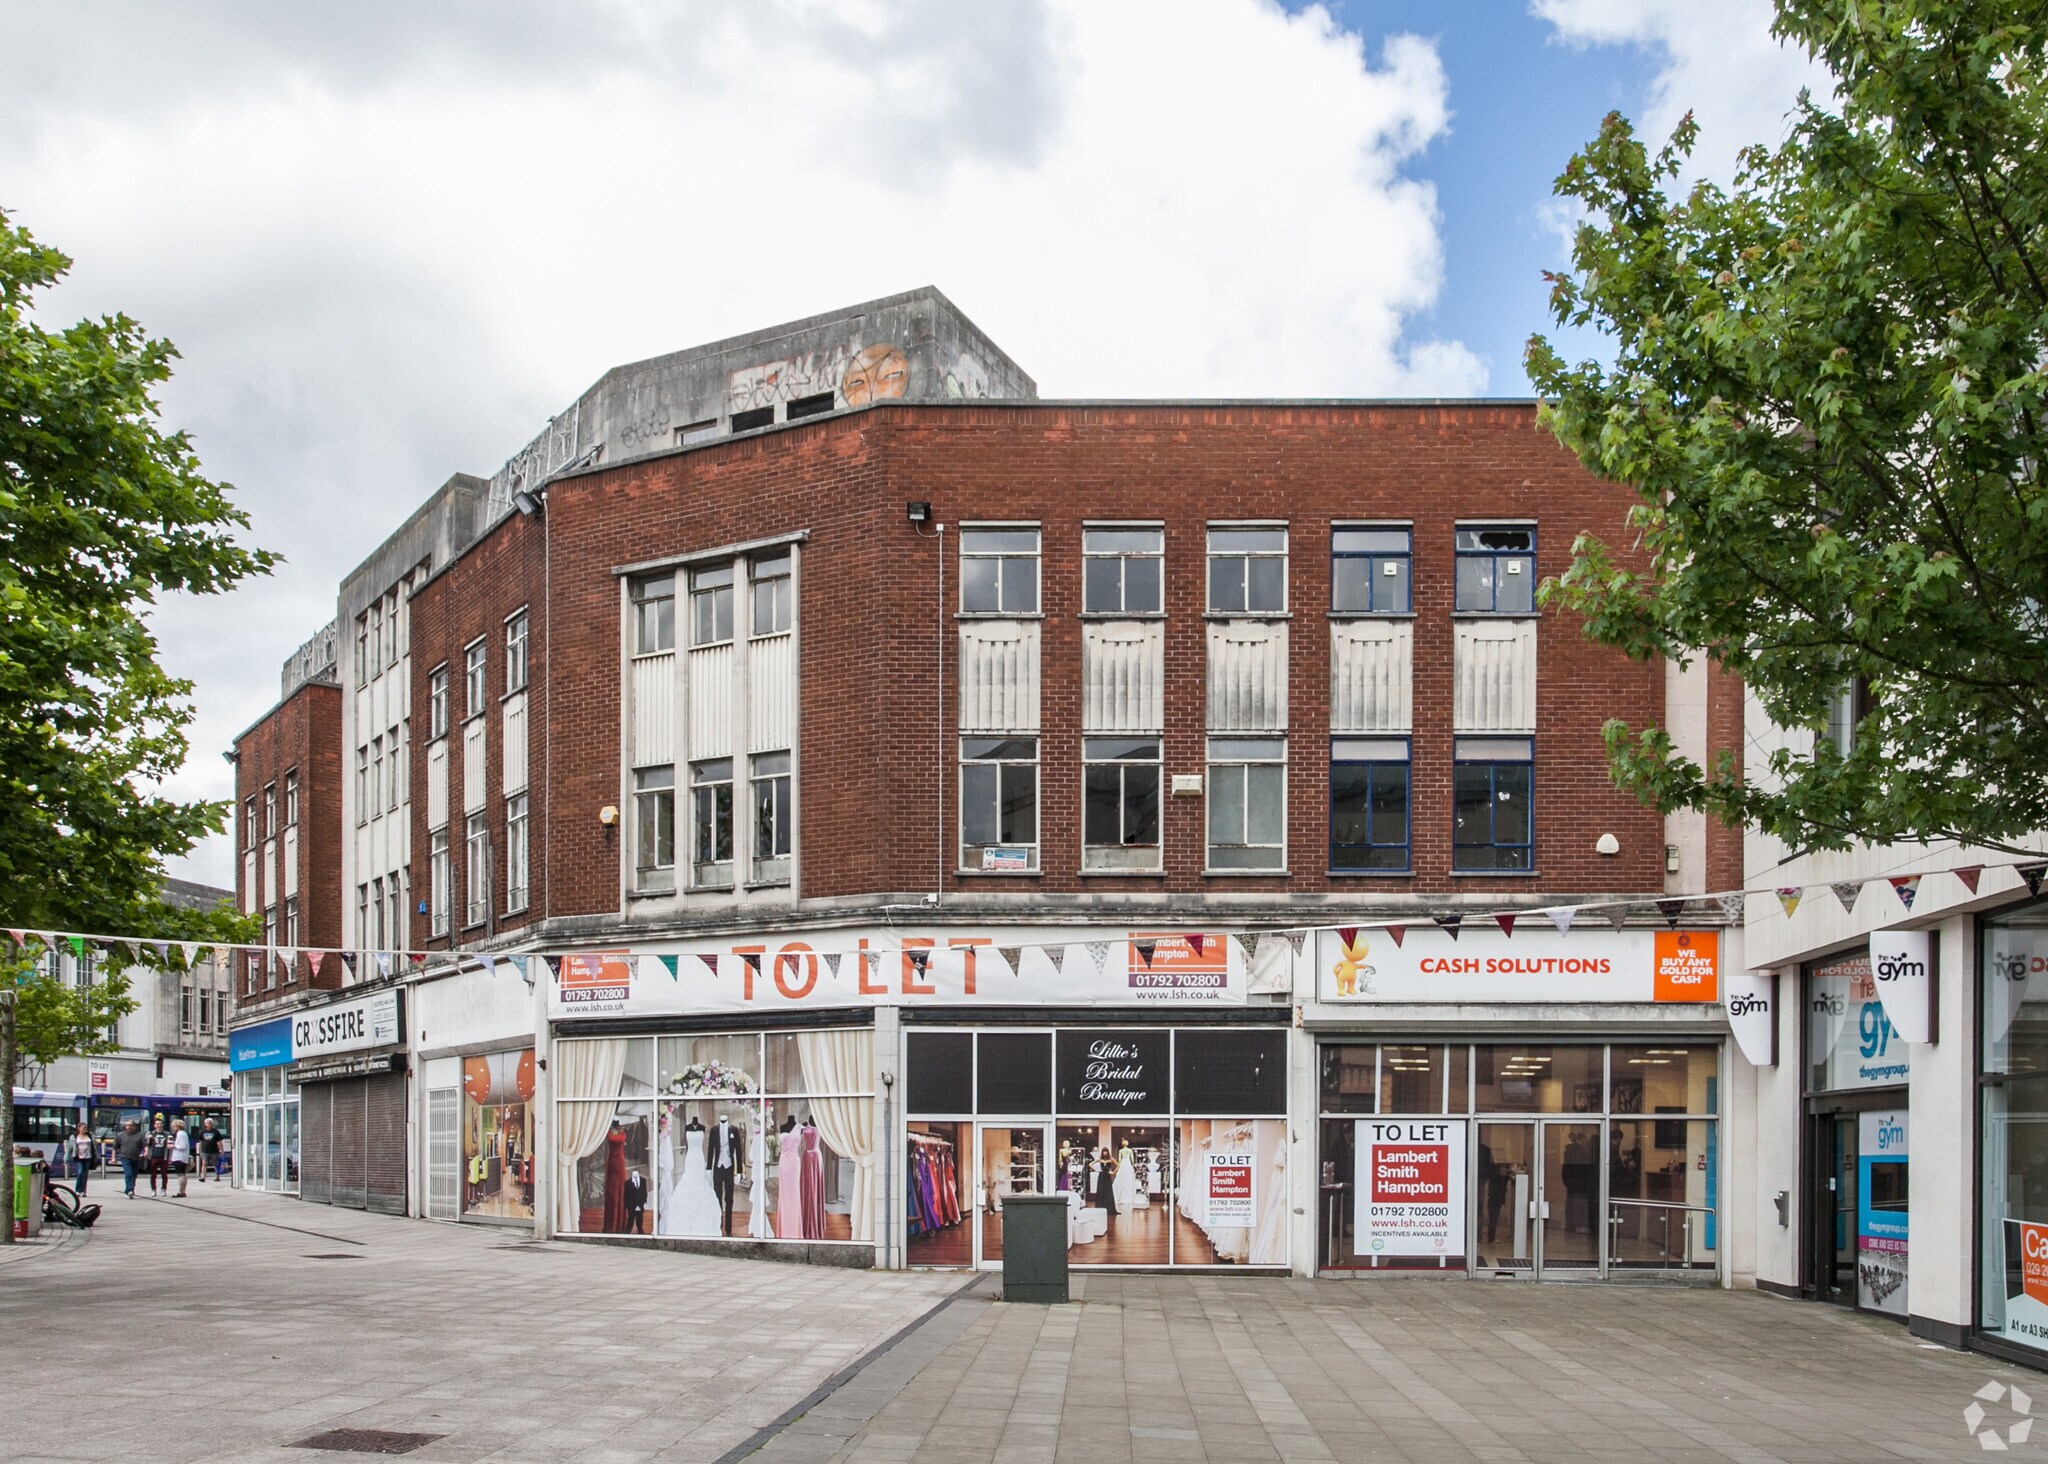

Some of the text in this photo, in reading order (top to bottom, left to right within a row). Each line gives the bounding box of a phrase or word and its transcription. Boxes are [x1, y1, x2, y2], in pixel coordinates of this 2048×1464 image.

[1155, 938, 1185, 948] mbert
[1153, 949, 1189, 960] ampton
[1678, 949, 1696, 958] WE
[732, 937, 992, 1000] TO LET
[1420, 958, 1610, 974] CASH SOLUTIONS
[1662, 958, 1712, 966] BUY ANY
[1659, 966, 1714, 975] GOLD FOR
[1878, 962, 1924, 982] gym
[1136, 974, 1220, 986] 01792 702800
[1671, 975, 1702, 984] CASH
[565, 988, 625, 1002] 01792 702800
[1136, 990, 1220, 1000] www.lsh.co.uk
[566, 1002, 624, 1012] www.lsh.co.uk
[1730, 1000, 1768, 1016] gym
[1859, 1001, 1899, 1058] gy
[1087, 1040, 1138, 1060] Lillie's
[100, 1062, 109, 1070] LET
[1086, 1061, 1143, 1080] Bridal
[1080, 1082, 1146, 1106] Boutique
[1372, 1124, 1448, 1141] TO LET
[1878, 1126, 1903, 1150] gym
[1210, 1156, 1251, 1165] TO LET
[1377, 1150, 1438, 1163] Lambert
[1212, 1169, 1246, 1177] Lambert
[1377, 1165, 1419, 1178] Smith
[1212, 1186, 1248, 1194] Hampton
[1377, 1180, 1443, 1196] Hampton
[1371, 1206, 1448, 1216] 01792 702800
[1371, 1219, 1448, 1228] www.lsh.co.uk
[2026, 1262, 2040, 1276] 029
[2011, 1319, 2019, 1331] A1
[2020, 1325, 2028, 1334] or
[2028, 1324, 2038, 1336] A3
